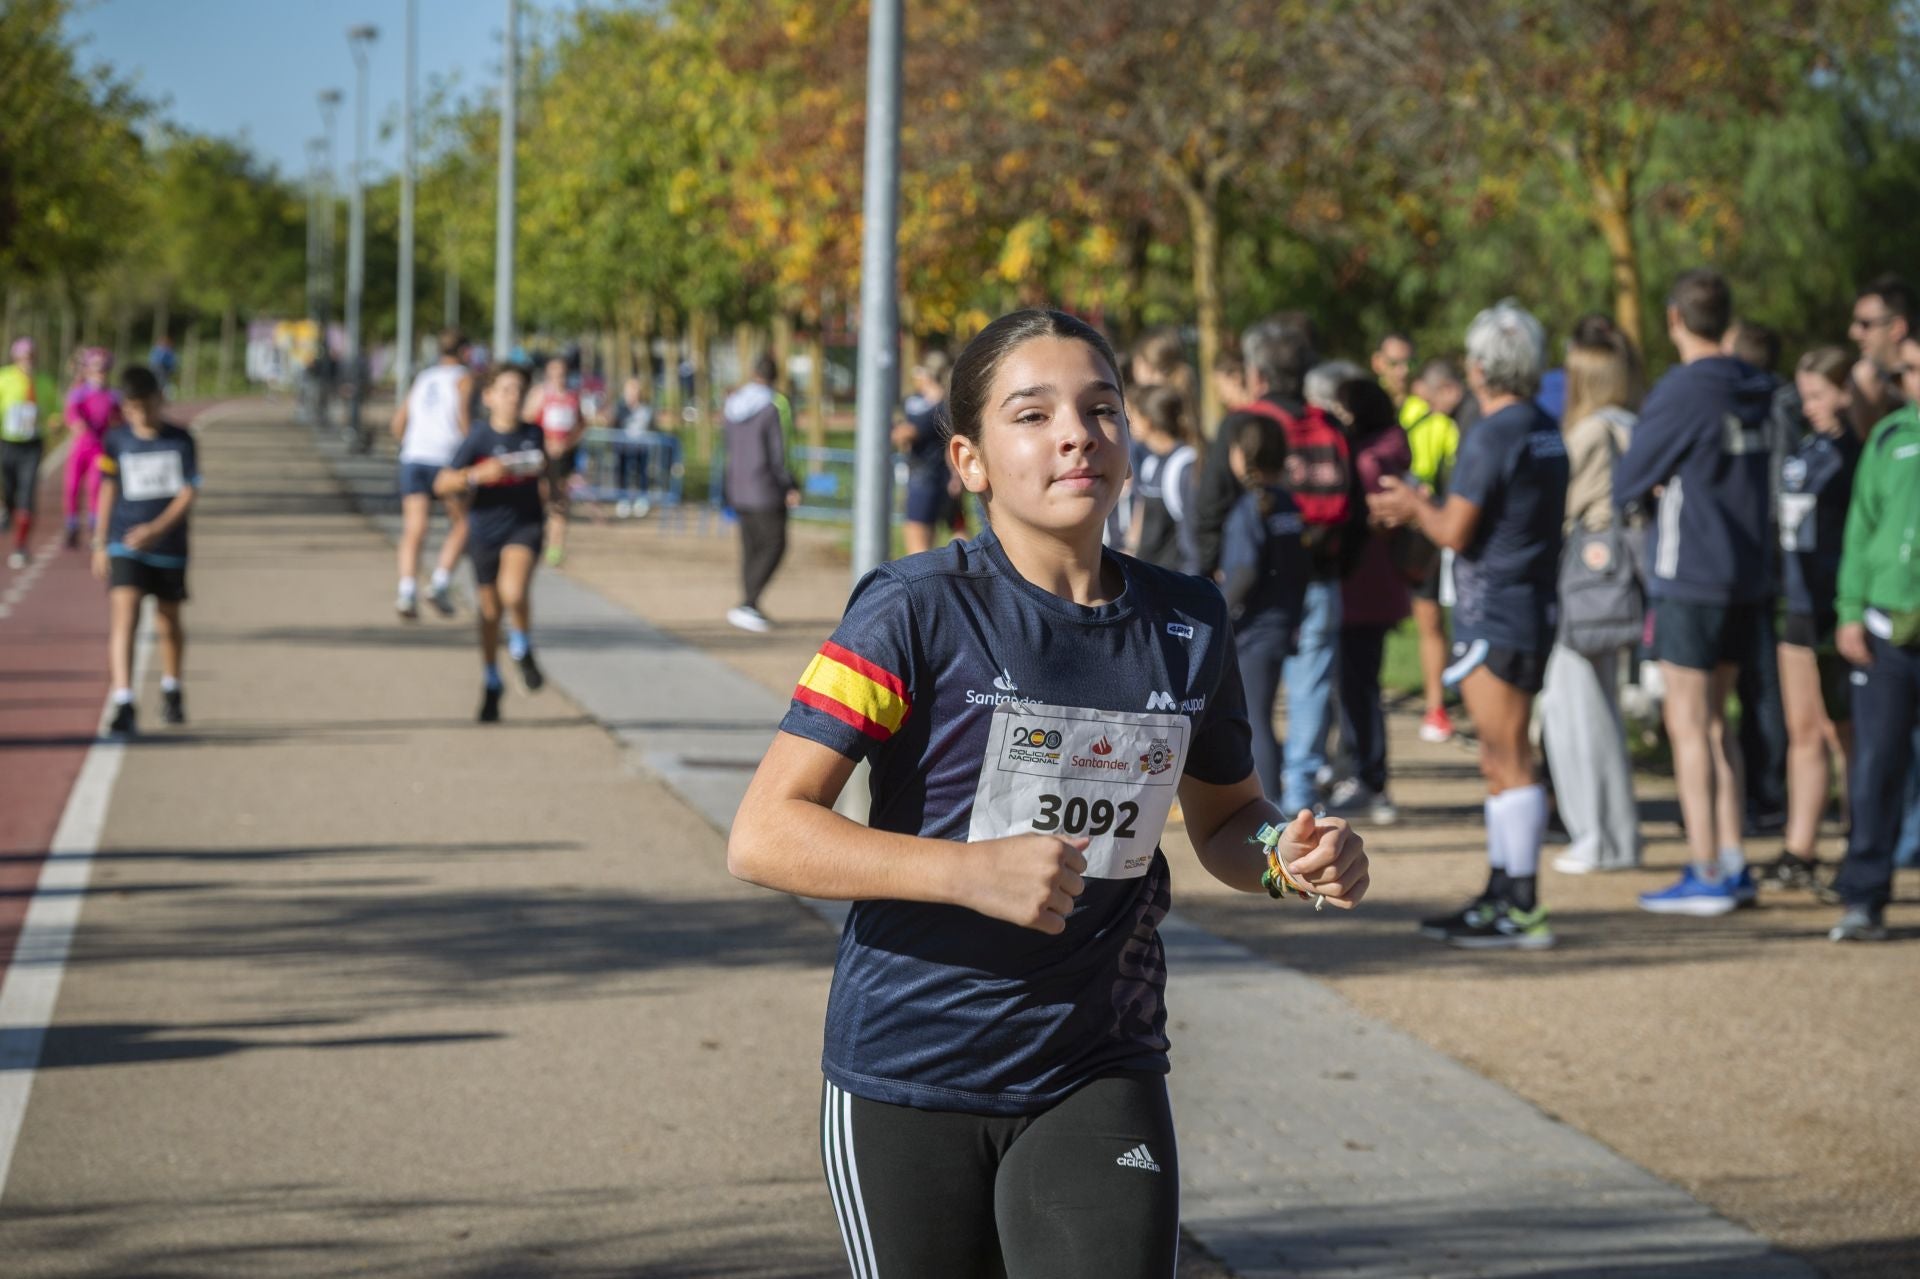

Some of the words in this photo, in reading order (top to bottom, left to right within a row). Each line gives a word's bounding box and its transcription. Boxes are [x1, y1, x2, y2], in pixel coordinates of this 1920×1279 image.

[1012, 726, 1063, 750] 200
[1008, 754, 1060, 765] NACIONAL
[1071, 755, 1129, 771] Santander
[1031, 794, 1140, 838] 3092
[1116, 1157, 1161, 1173] adidas
